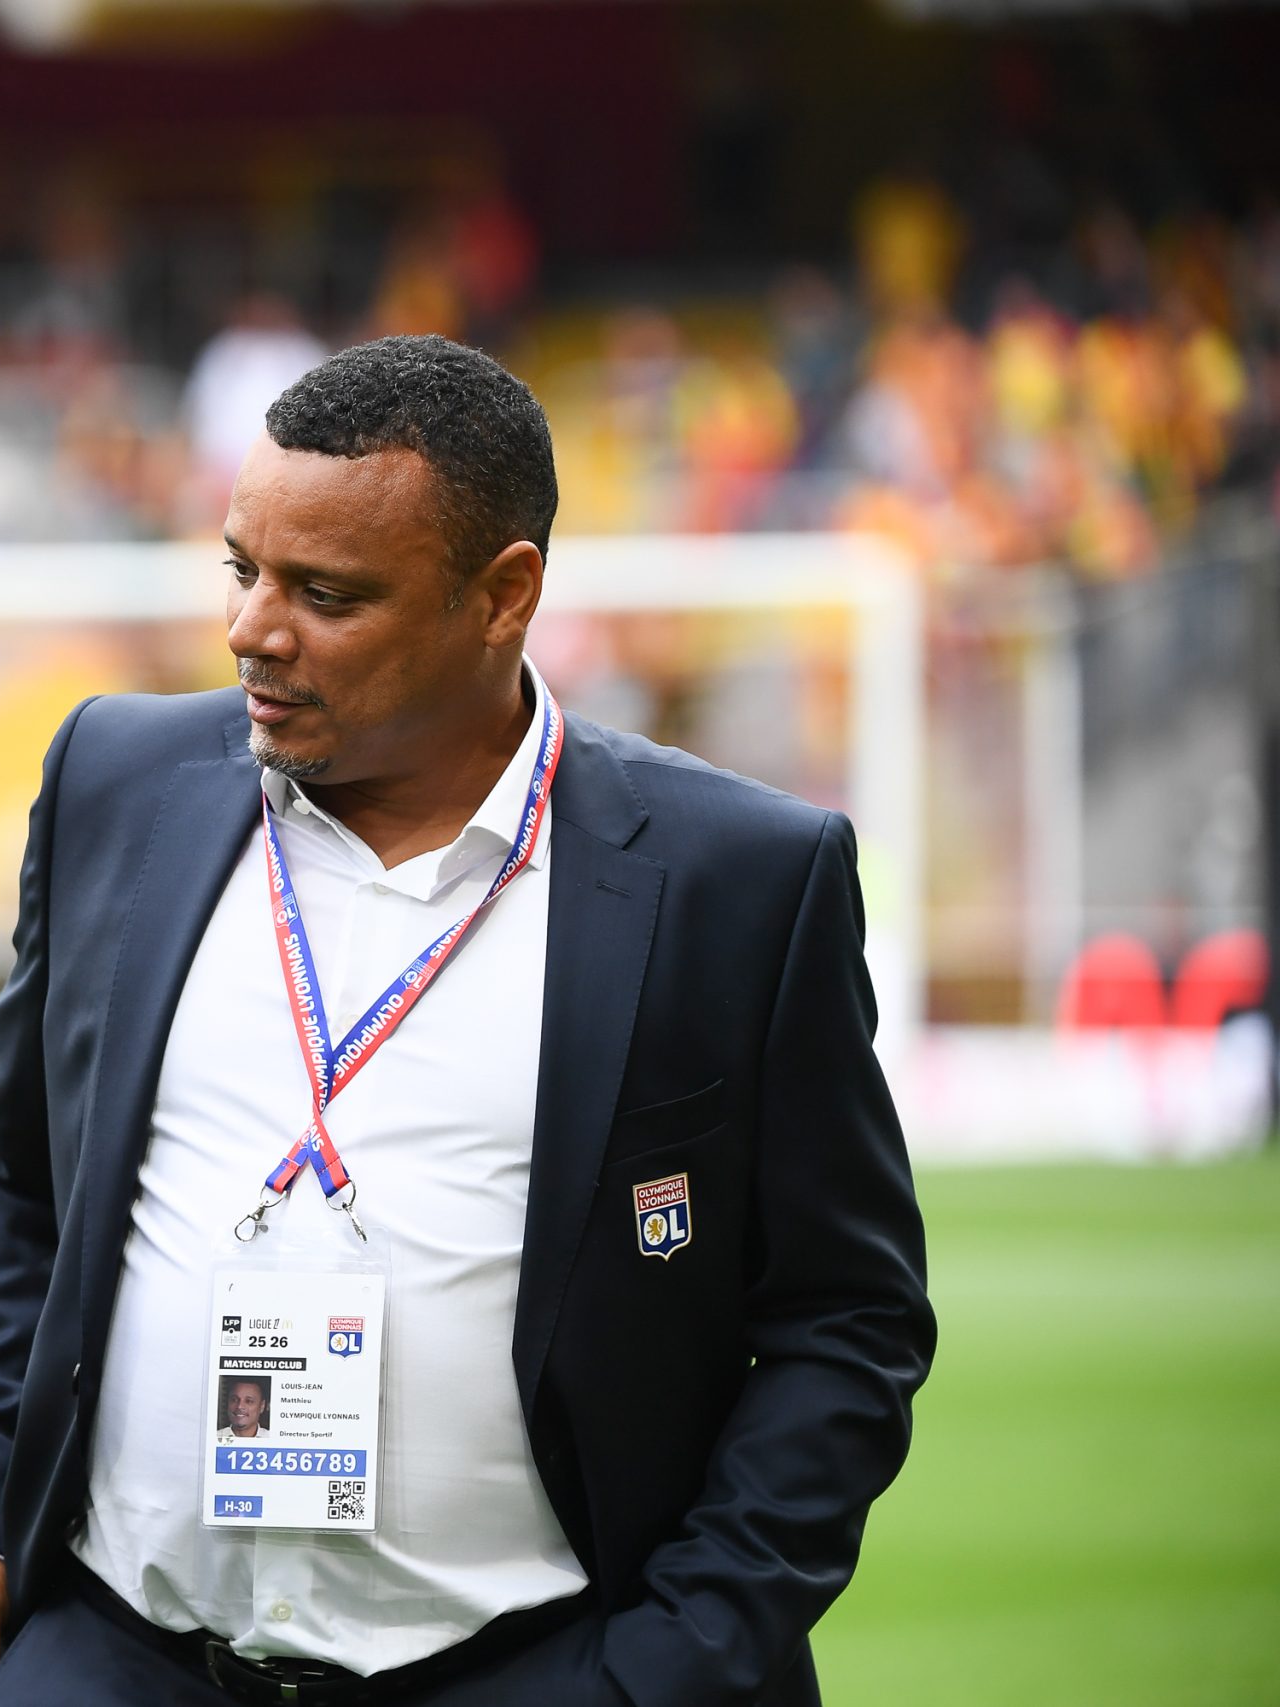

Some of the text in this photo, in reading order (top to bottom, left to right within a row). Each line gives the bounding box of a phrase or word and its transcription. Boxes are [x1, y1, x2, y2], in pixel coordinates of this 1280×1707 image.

[493, 806, 537, 893] OLYMPIQUE
[283, 933, 328, 1111] OLYMPIQUE LYONNAIS
[333, 993, 404, 1079] OLYMPIQUE
[638, 1179, 684, 1198] OLYMPIQUE
[639, 1189, 685, 1209] LYONNAIS
[643, 1208, 685, 1246] OL
[249, 1318, 272, 1329] LIGUE
[248, 1335, 266, 1348] 25
[270, 1335, 288, 1348] 26
[330, 1333, 360, 1352] OL
[223, 1360, 303, 1370] MATCHS DU CLUB
[280, 1412, 322, 1420] OLYMPIQUE
[310, 1431, 333, 1439] Sportif
[227, 1450, 357, 1473] 123456789
[224, 1501, 253, 1512] H-30
